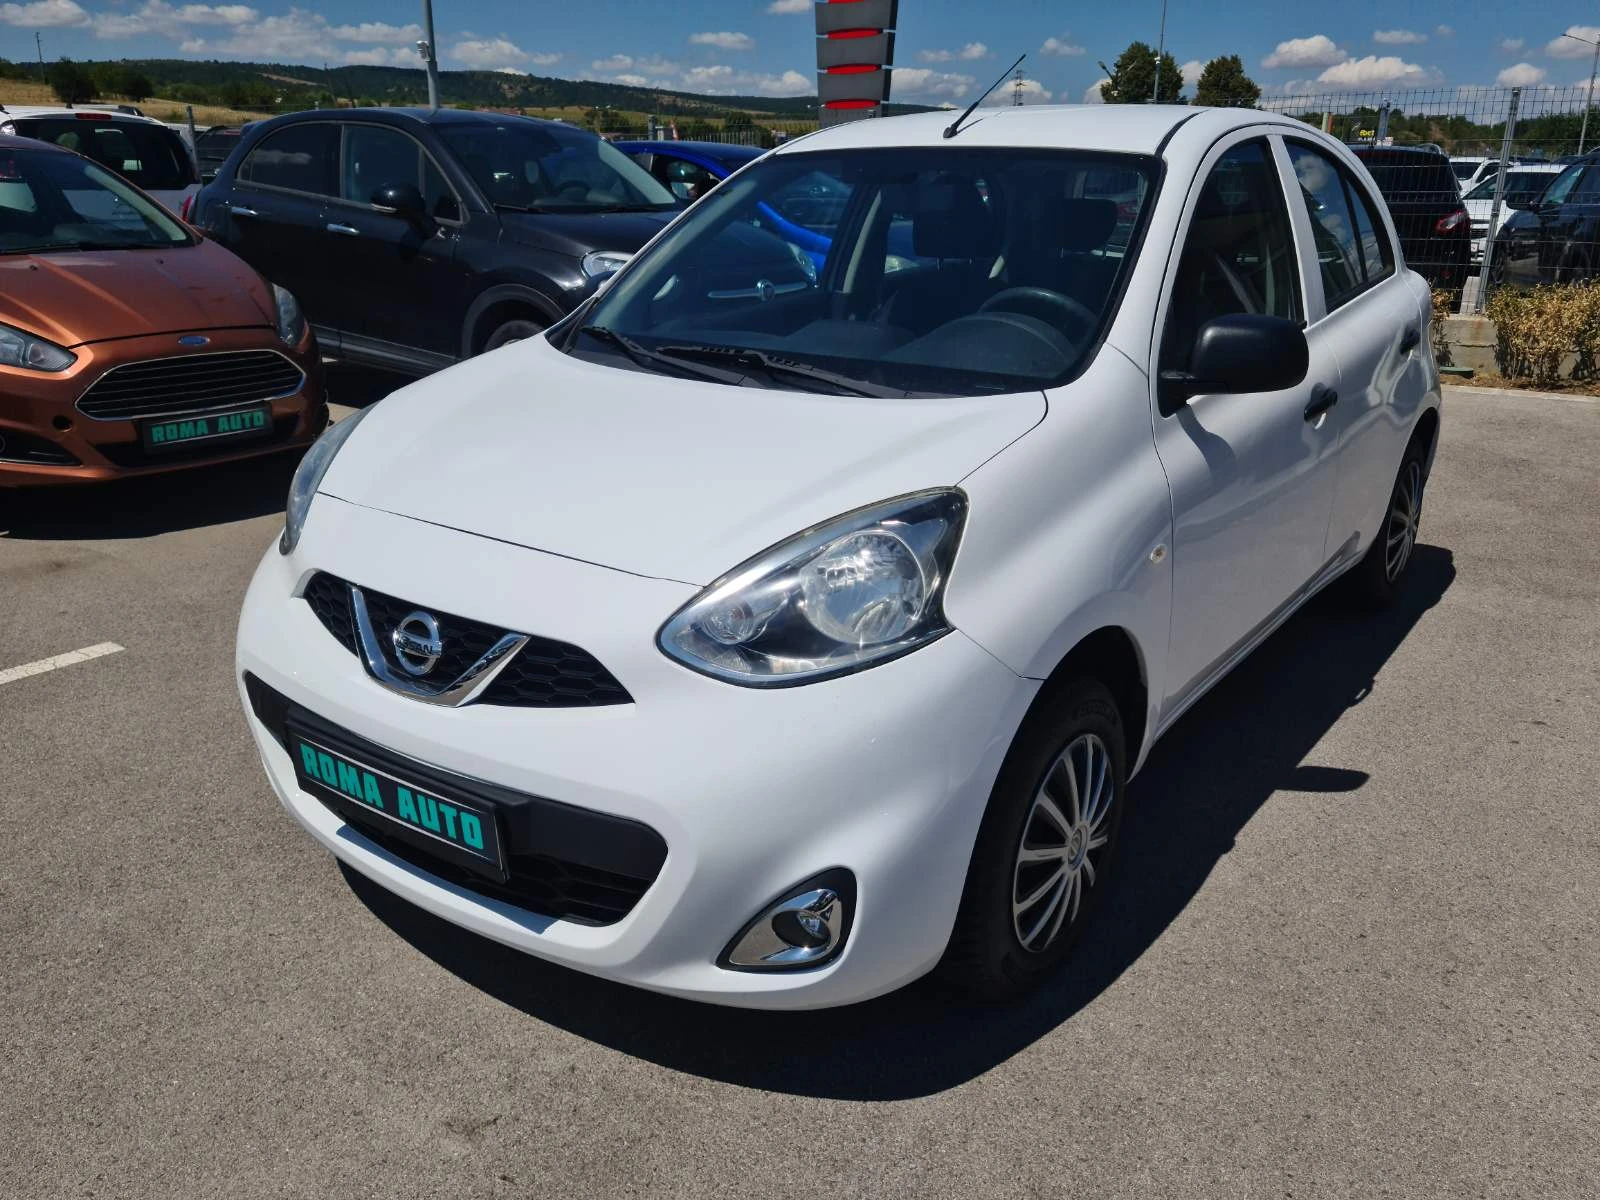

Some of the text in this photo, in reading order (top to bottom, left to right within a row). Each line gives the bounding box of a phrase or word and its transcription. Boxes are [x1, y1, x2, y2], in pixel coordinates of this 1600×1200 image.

[151, 411, 265, 443] ROMA AUTO
[299, 743, 484, 850] ROMA AUTO
